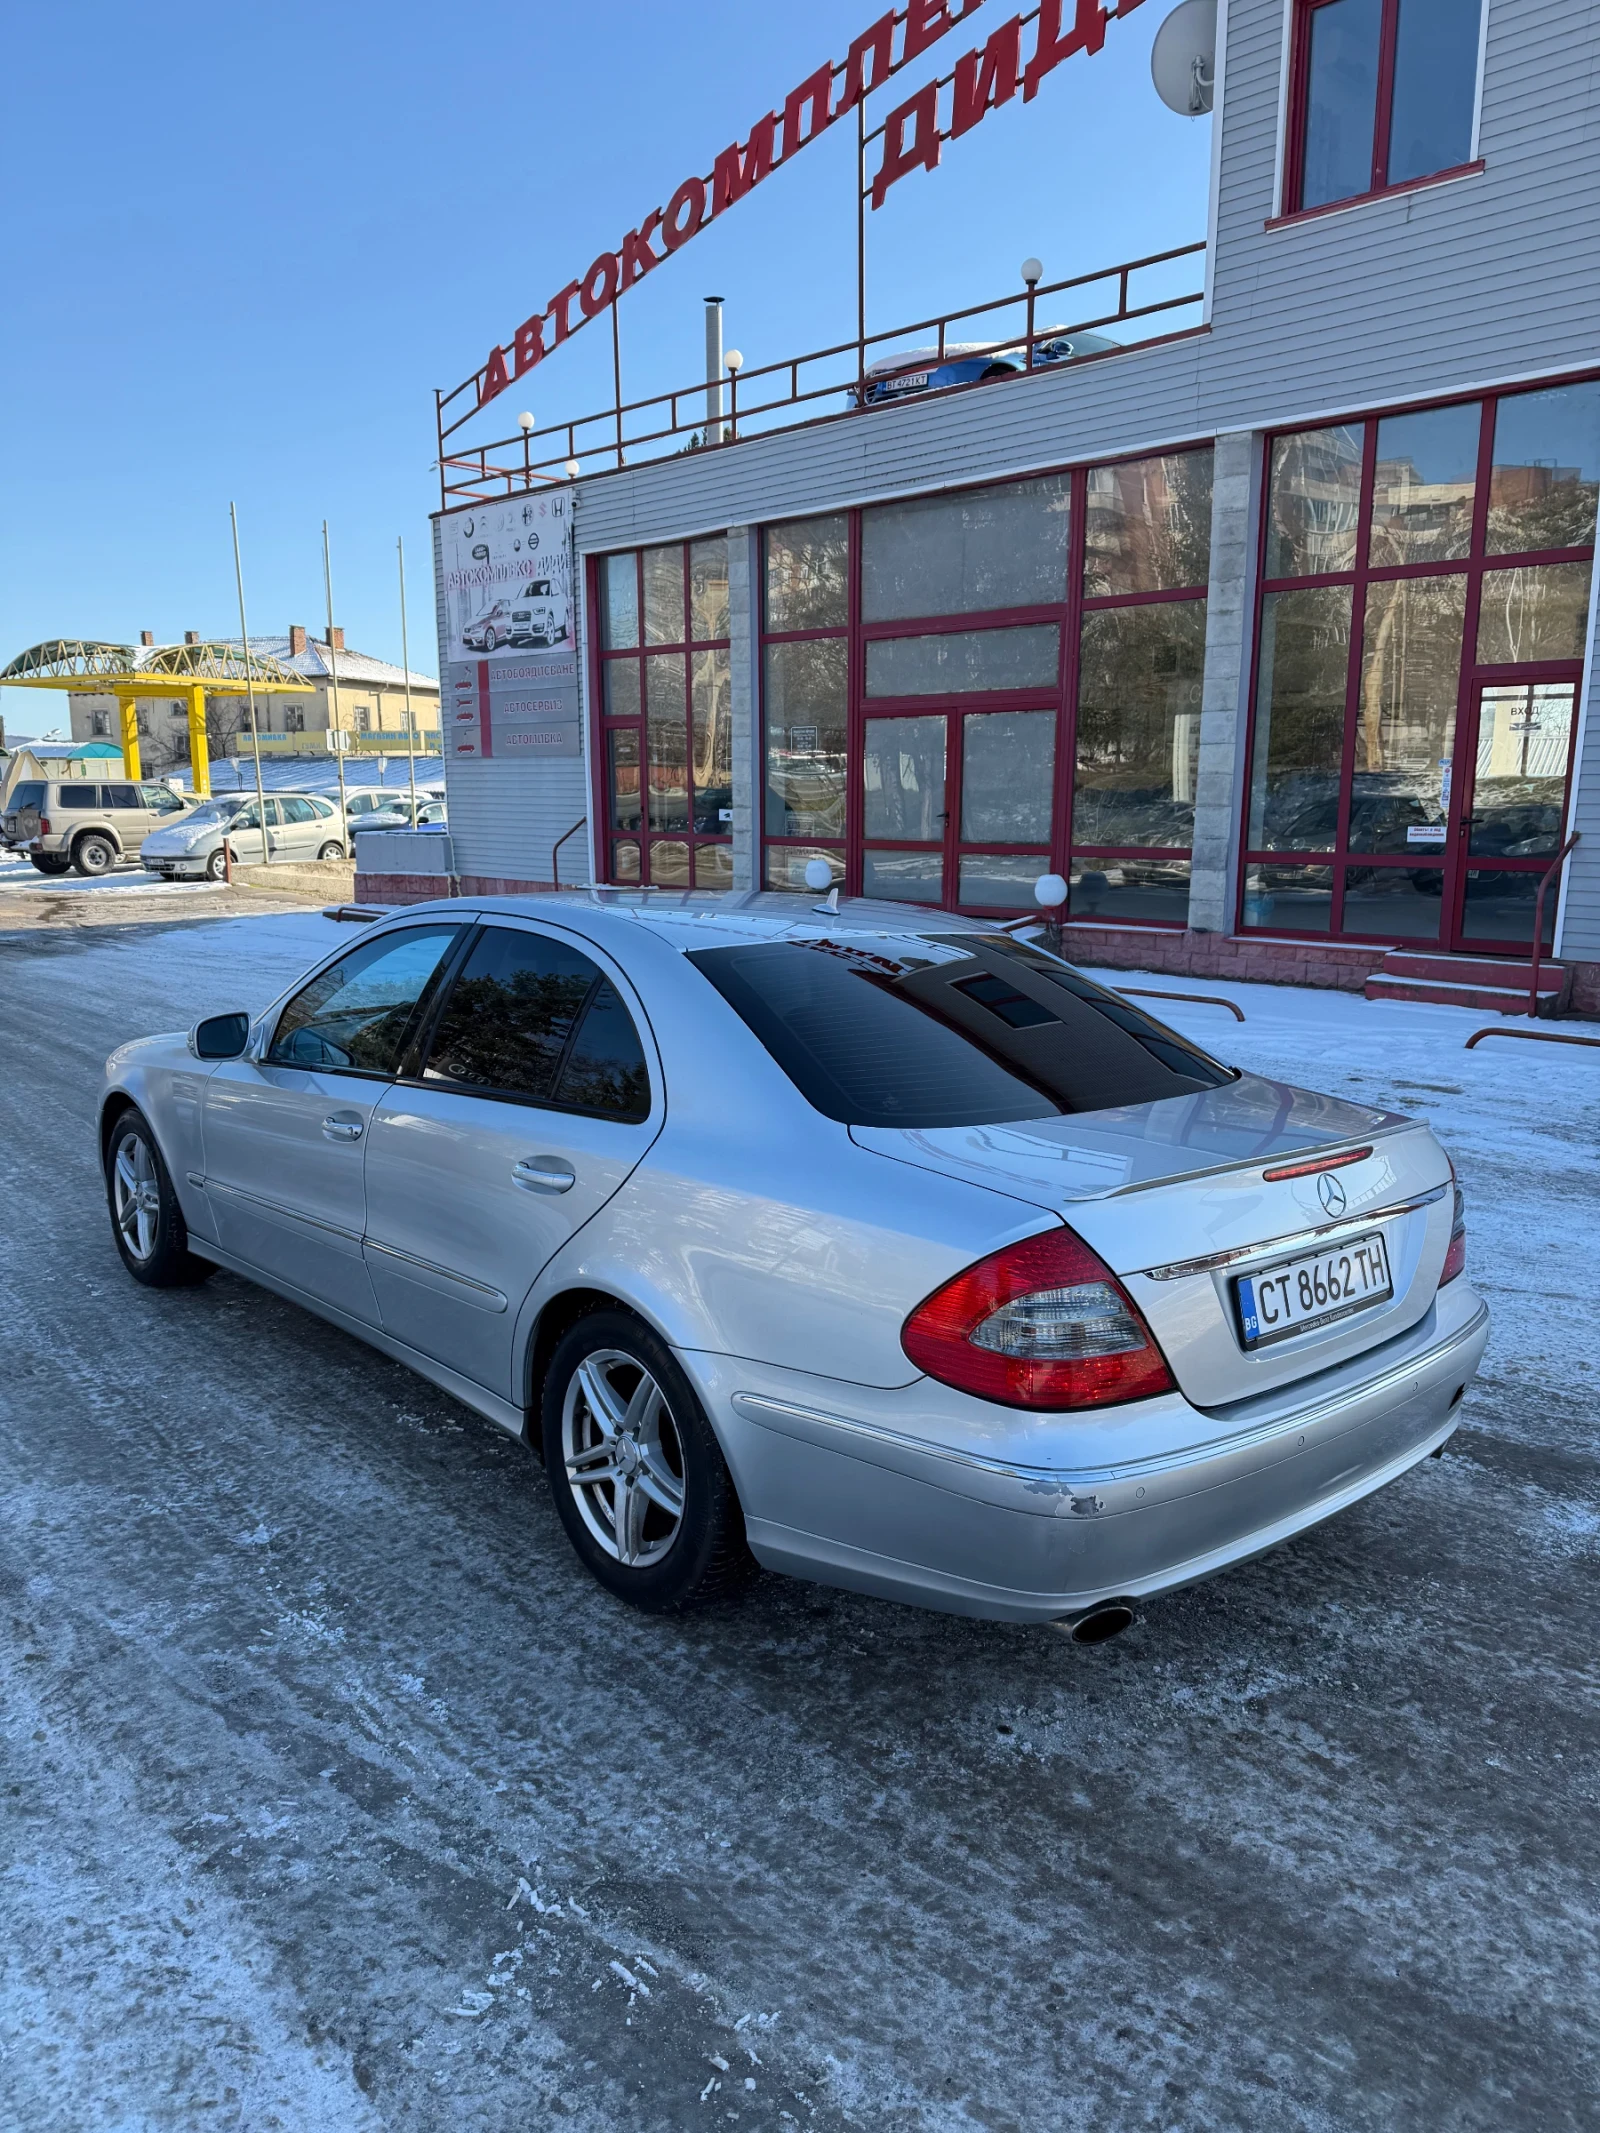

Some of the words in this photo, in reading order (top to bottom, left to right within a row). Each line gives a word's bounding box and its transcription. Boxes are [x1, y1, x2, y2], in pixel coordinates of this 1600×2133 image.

[871, 0, 1148, 211] ДИД
[479, 0, 987, 408] АВТОКОМПЛЕ
[887, 380, 896, 389] BT
[897, 377, 914, 387] 4721
[915, 375, 926, 385] KT
[448, 559, 533, 589] АВТОКОМПЛЕКС
[491, 663, 576, 681] АВТОБОЯДИСВАНЕ
[504, 699, 563, 714] АВТОСЕРВИЗ
[1510, 706, 1540, 716] ВХОД
[243, 733, 287, 742] АВОМИВКА
[397, 731, 419, 740] АВО
[506, 732, 563, 746] АВТОМИВКА
[1259, 1274, 1291, 1324] CT
[1297, 1256, 1356, 1311] 8662
[1354, 1244, 1386, 1290] TH
[1245, 1315, 1258, 1331] BG
